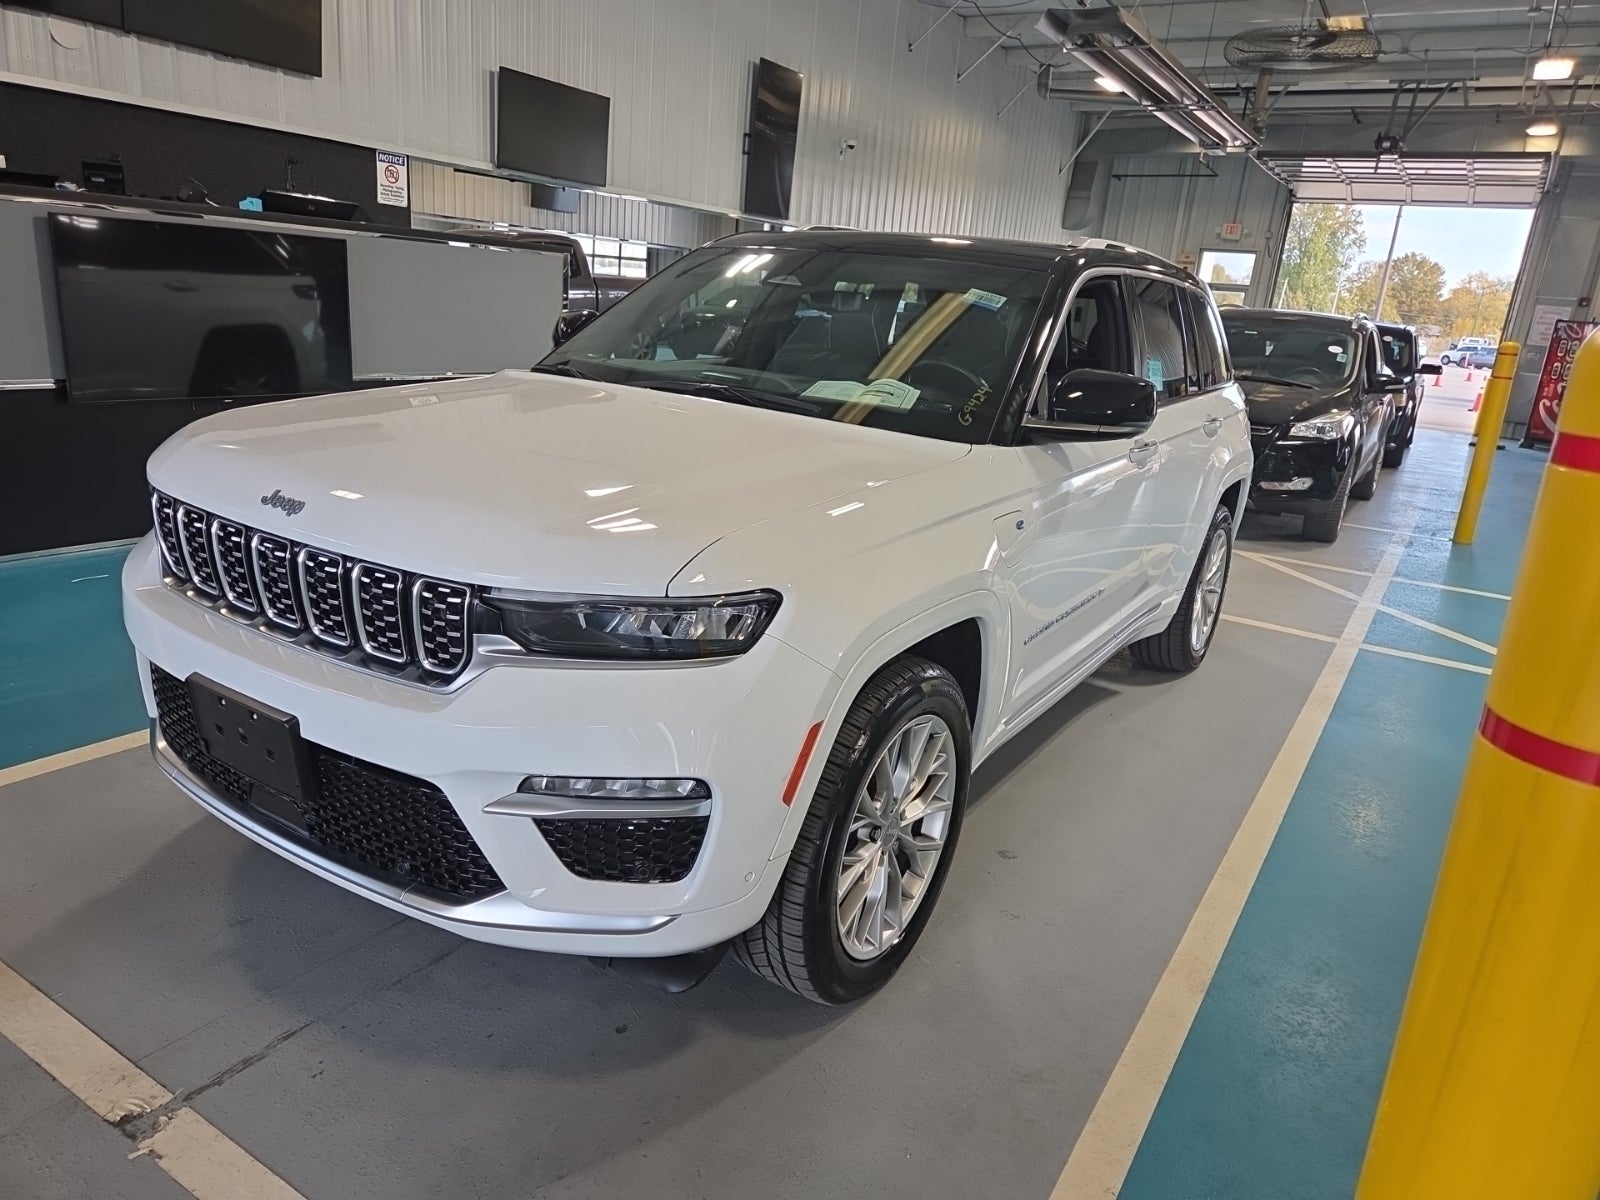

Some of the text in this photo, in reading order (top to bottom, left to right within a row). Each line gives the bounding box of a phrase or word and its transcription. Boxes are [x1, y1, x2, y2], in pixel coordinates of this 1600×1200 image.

[379, 154, 404, 165] NOTICE
[1225, 225, 1239, 235] EXIT
[958, 386, 993, 426] G9424
[261, 489, 305, 516] Jeep
